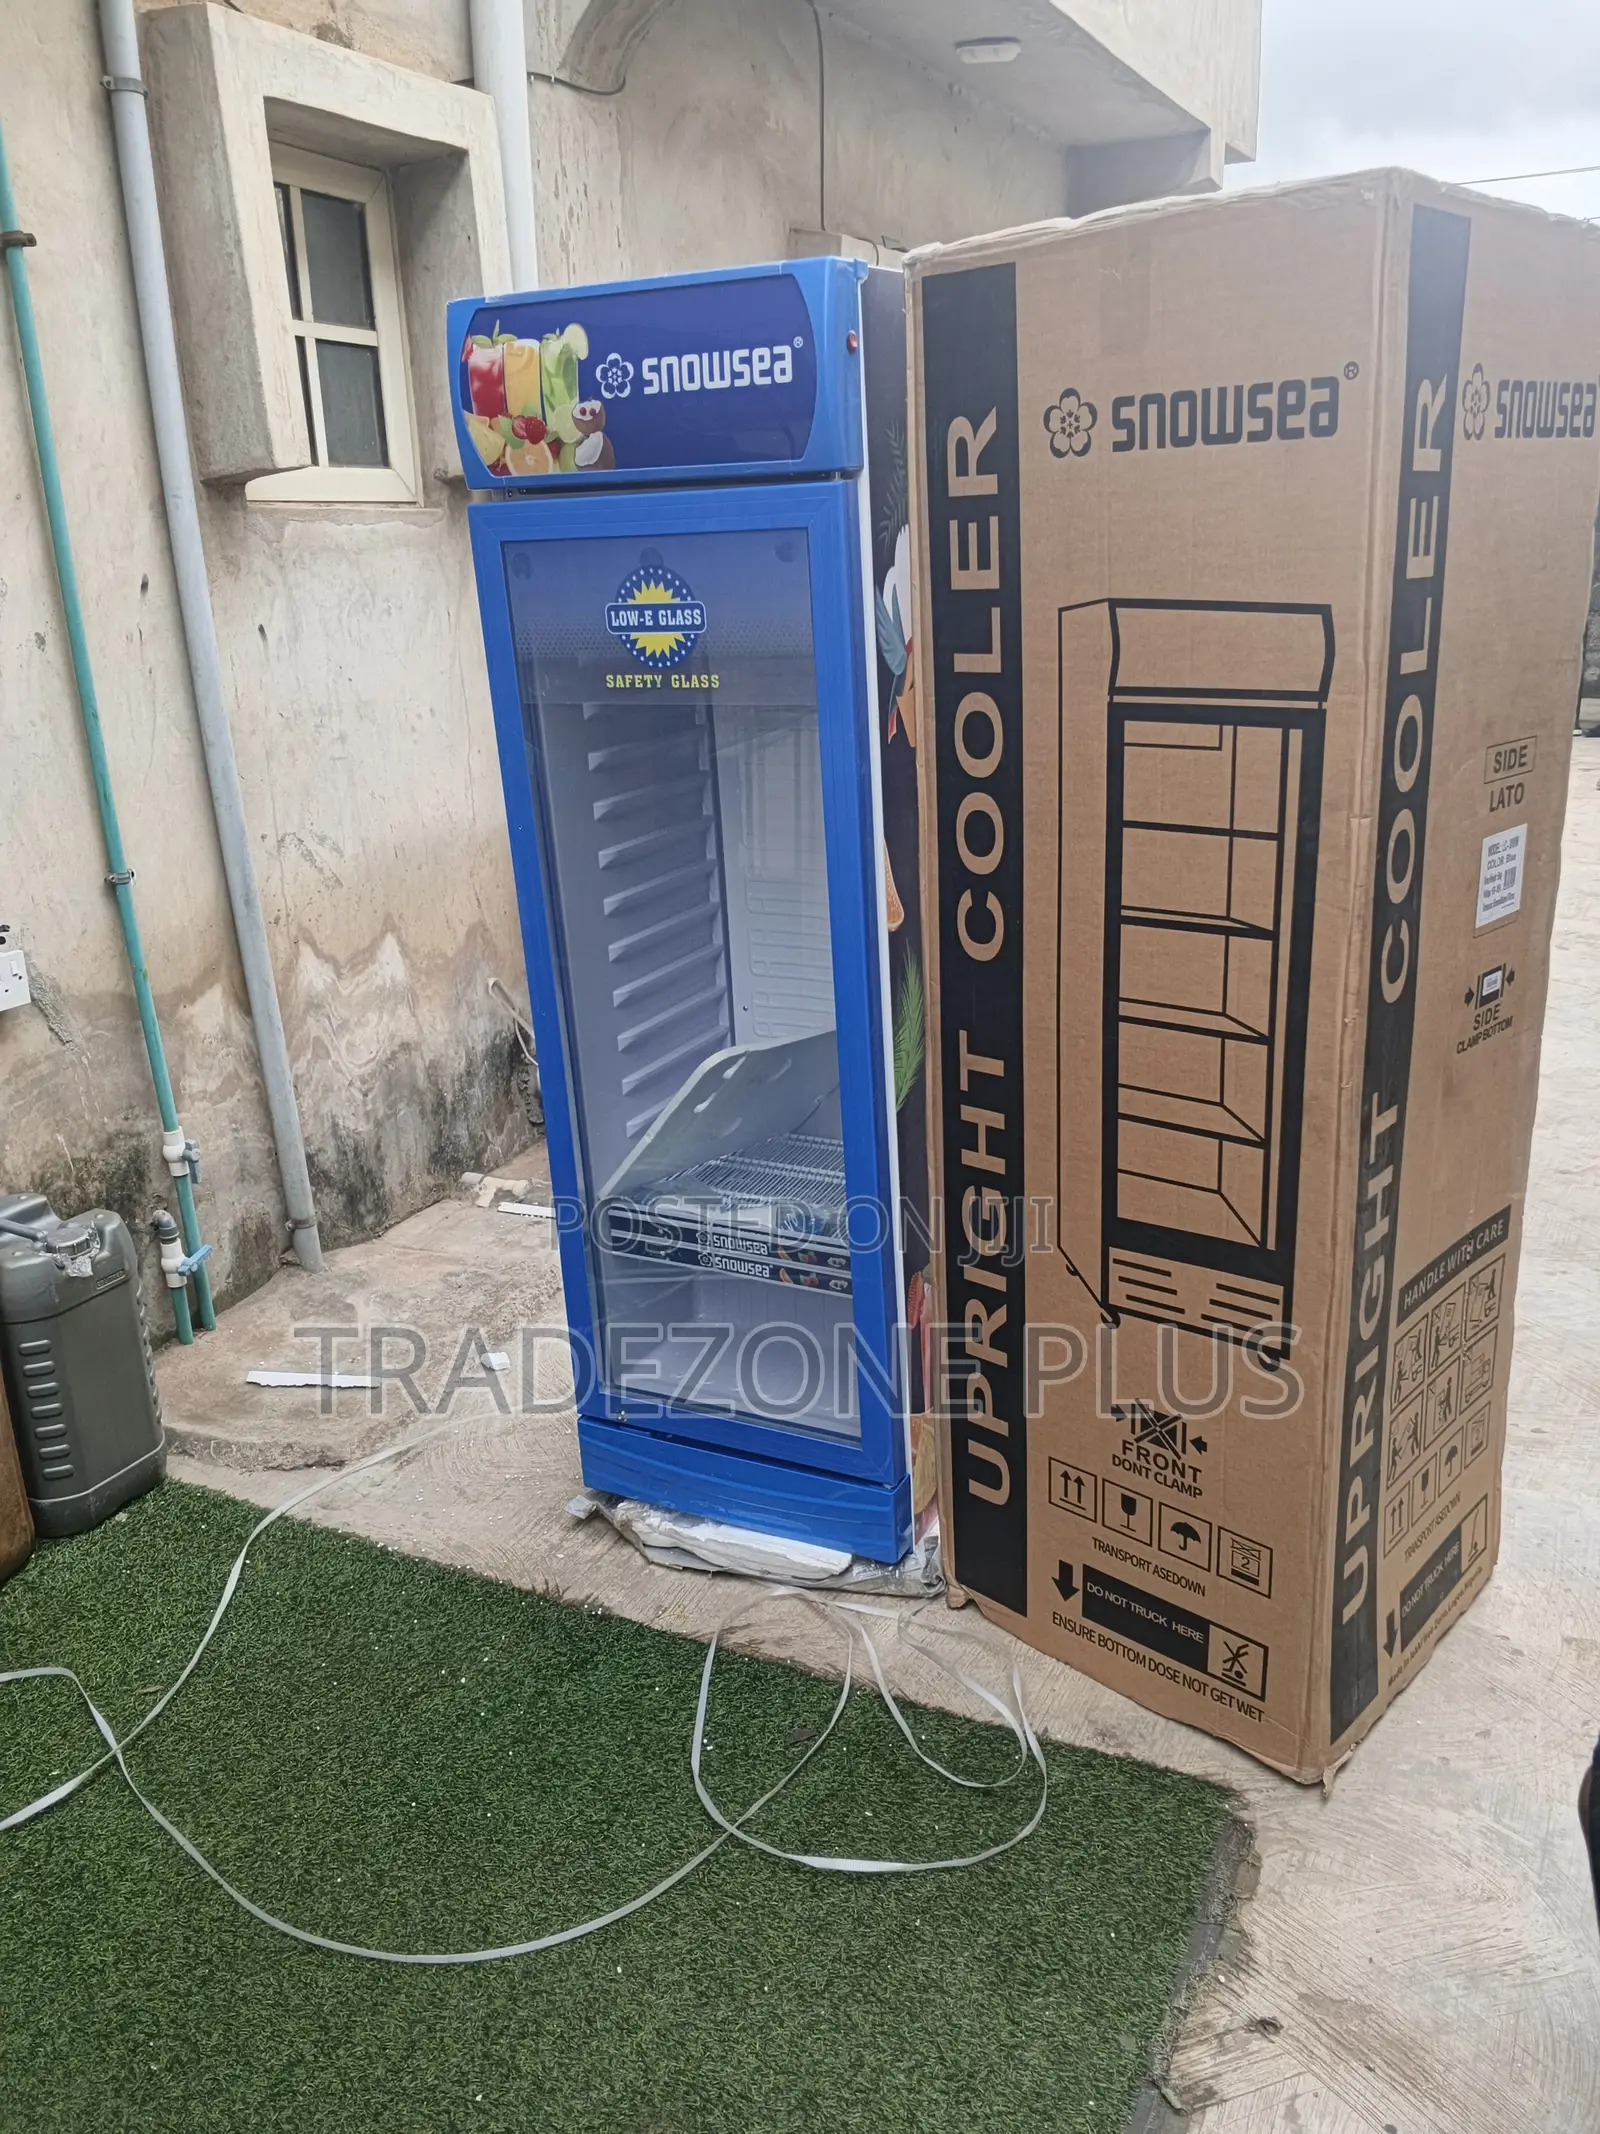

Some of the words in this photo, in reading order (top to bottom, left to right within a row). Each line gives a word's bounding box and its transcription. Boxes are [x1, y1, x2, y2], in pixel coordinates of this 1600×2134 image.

[610, 609, 654, 627] LOW-E
[658, 608, 702, 626] GLASS
[605, 674, 663, 688] SAFETY
[671, 674, 720, 688] GLASS
[947, 405, 1005, 963] COOLER
[1493, 744, 1528, 775] SIDE
[1488, 782, 1525, 813] LATO
[1341, 1089, 1398, 1625] UPRIGHT
[1380, 372, 1447, 1005] COOLER
[1473, 1003, 1501, 1032] SIDE
[1456, 1031, 1483, 1055] CLAMP
[1482, 1015, 1514, 1042] BOTTOM
[958, 1029, 1013, 1506] UPRIGHT
[1403, 1261, 1446, 1311] HANDLE
[1447, 1239, 1475, 1273] WITH
[1476, 1219, 1504, 1250] CARE
[1111, 1453, 1152, 1480] DONT
[1153, 1471, 1203, 1500] CLAMP
[1121, 1439, 1203, 1484] FRONT
[1091, 1537, 1152, 1573] TRANSPORT
[1152, 1564, 1206, 1597] ASEDOWN
[1240, 1556, 1251, 1571] 2
[1086, 1582, 1104, 1598] DO
[1105, 1589, 1128, 1609] NOT
[1128, 1598, 1168, 1628] TRUCK
[1172, 1620, 1205, 1644] HERE
[1401, 1600, 1412, 1618] DO
[1424, 1563, 1445, 1591] TRUCK
[1052, 1611, 1096, 1645] ENSURE
[1098, 1633, 1147, 1669] BOTTOM
[1148, 1657, 1181, 1685] DOSE
[1182, 1673, 1209, 1697] NOT
[1210, 1687, 1237, 1709] GET
[1237, 1698, 1265, 1723] WET
